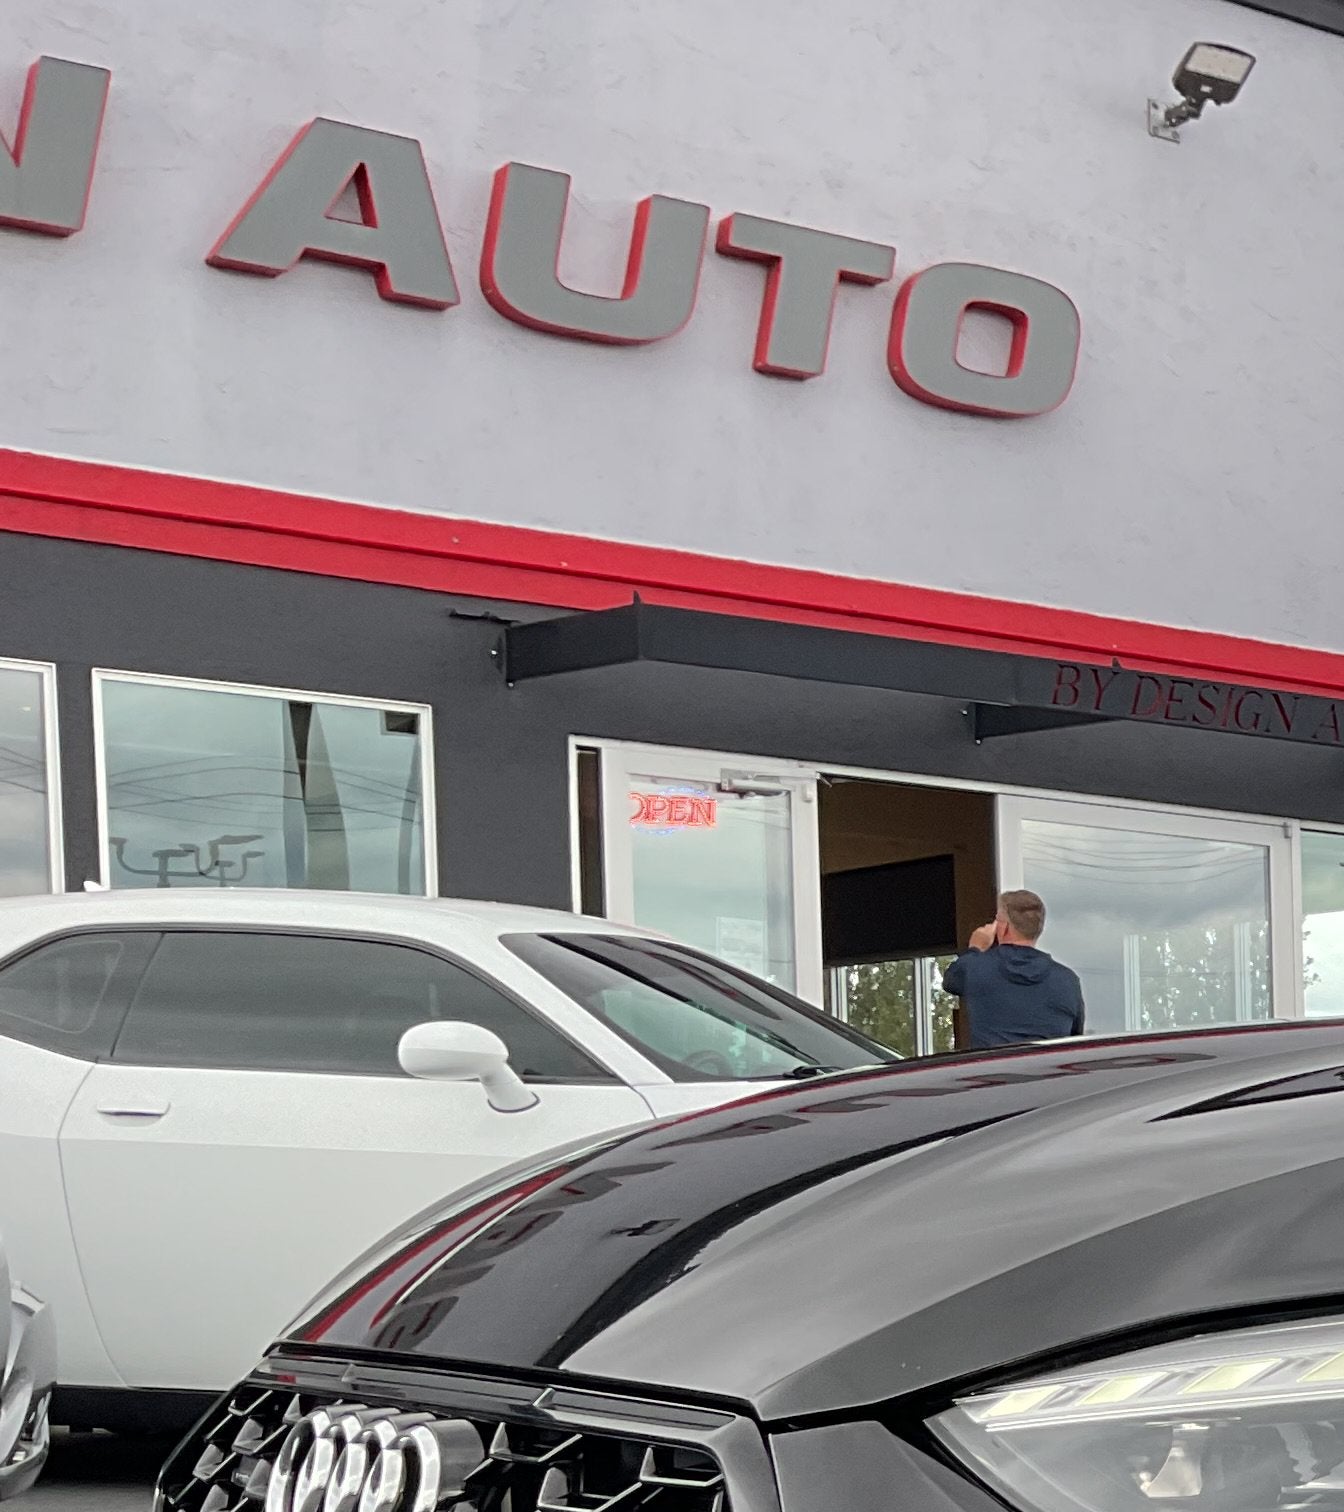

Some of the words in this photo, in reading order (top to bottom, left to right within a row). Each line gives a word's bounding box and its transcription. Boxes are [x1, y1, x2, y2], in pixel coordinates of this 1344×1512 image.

[205, 116, 1082, 418] AUTO
[1052, 663, 1120, 711] BY
[1131, 674, 1300, 733] DESIGN
